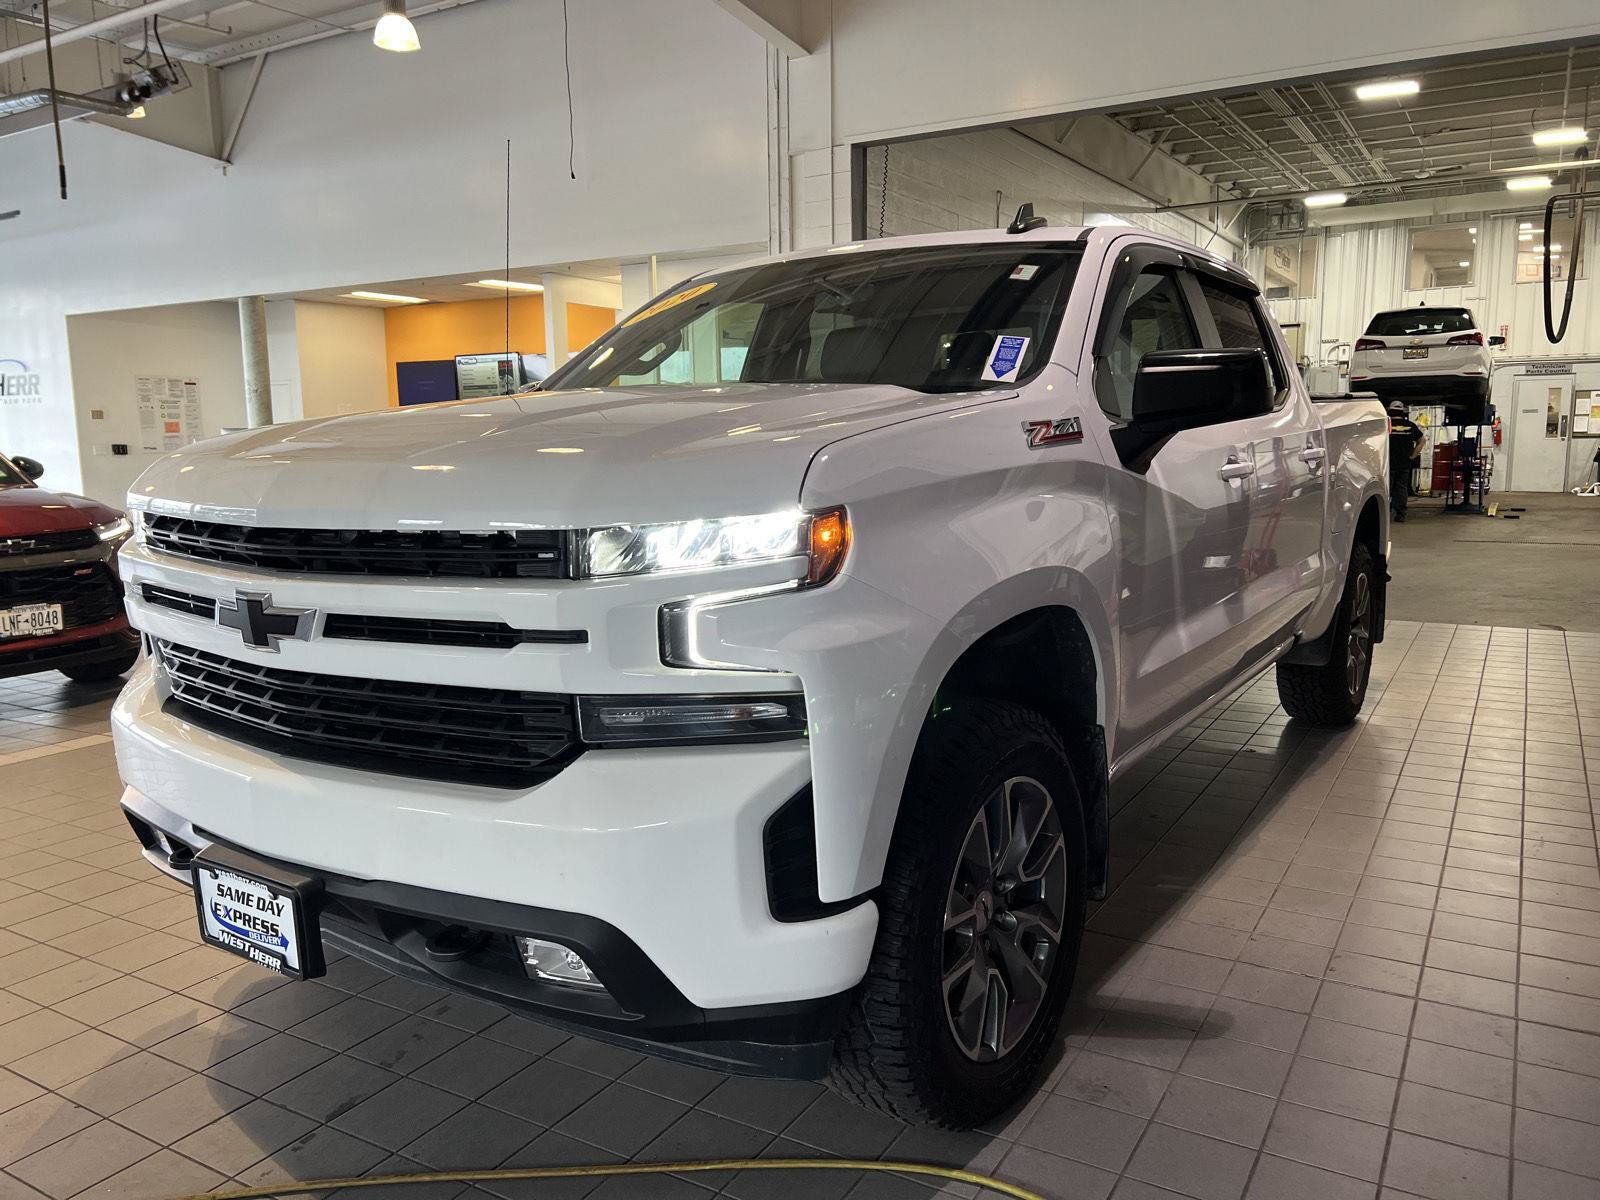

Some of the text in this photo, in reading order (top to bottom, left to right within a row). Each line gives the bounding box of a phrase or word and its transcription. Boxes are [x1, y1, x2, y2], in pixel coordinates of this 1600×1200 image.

[1021, 416, 1083, 450] Z71
[217, 883, 284, 917] SAME DAY
[214, 902, 280, 937] EXPRESS
[249, 931, 282, 946] DELIVERY
